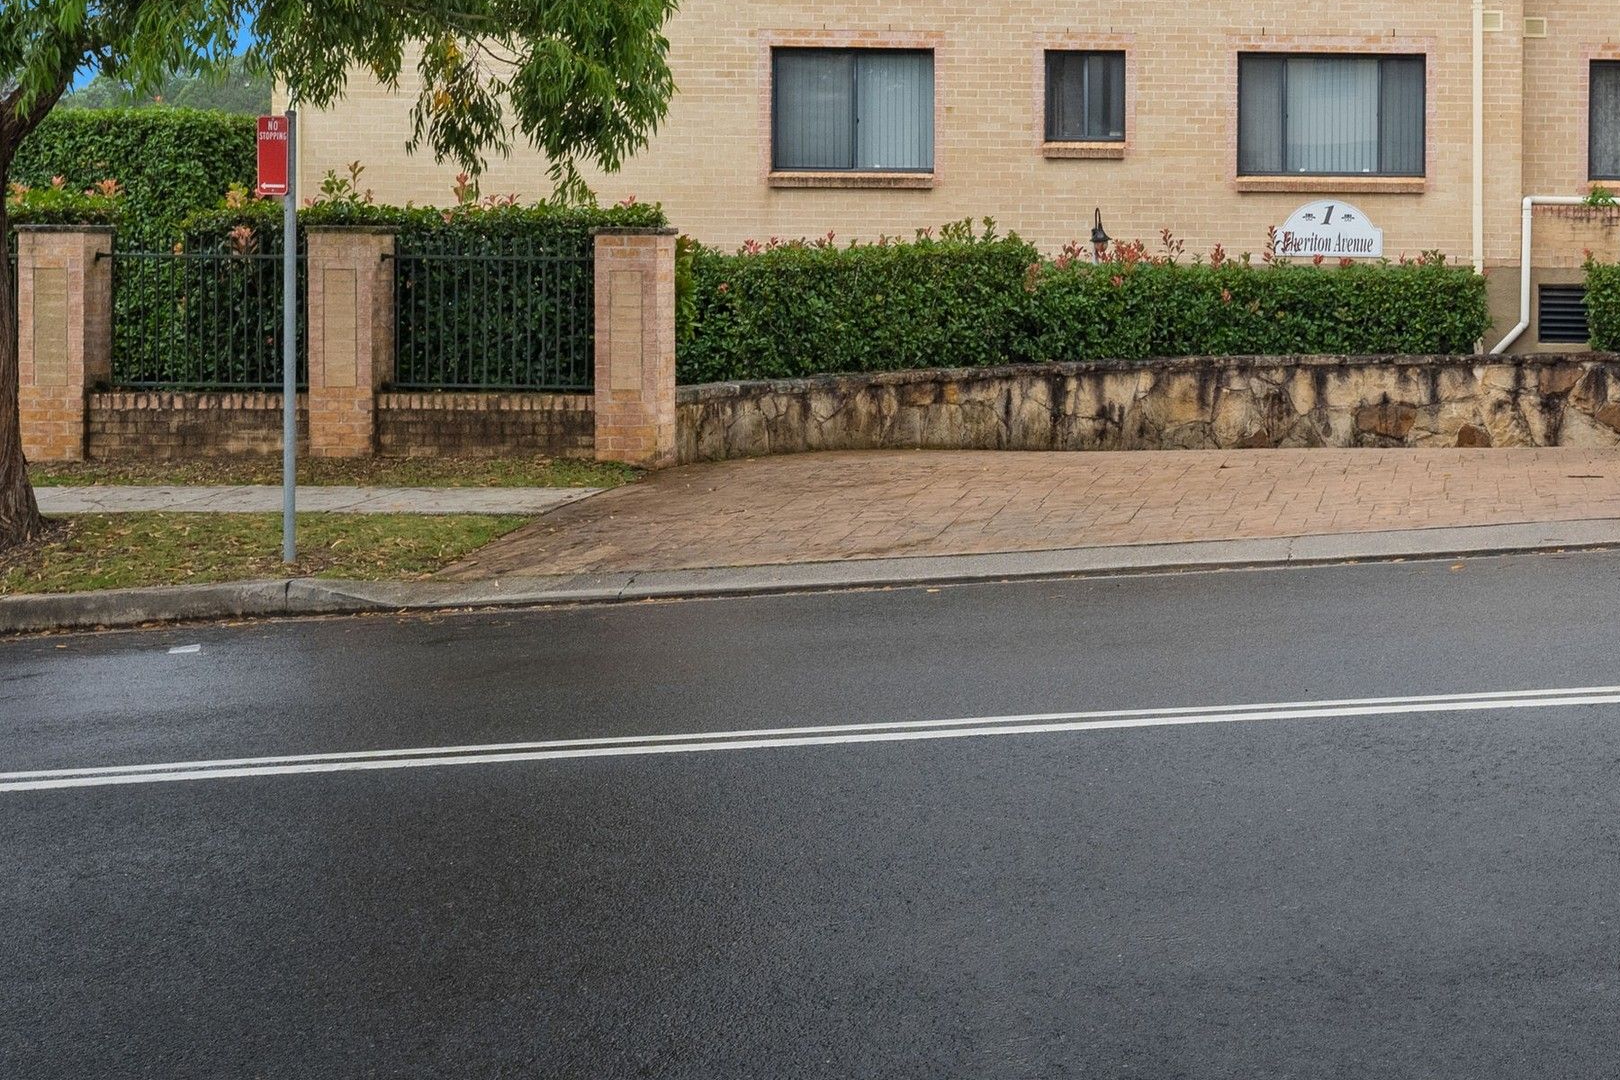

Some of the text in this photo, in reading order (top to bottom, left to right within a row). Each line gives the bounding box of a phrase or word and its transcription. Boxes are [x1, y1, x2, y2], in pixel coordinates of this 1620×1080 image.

[268, 120, 278, 131] NO
[259, 131, 287, 140] STOPPING
[1320, 205, 1335, 225] 1
[1333, 232, 1374, 253] Avenue
